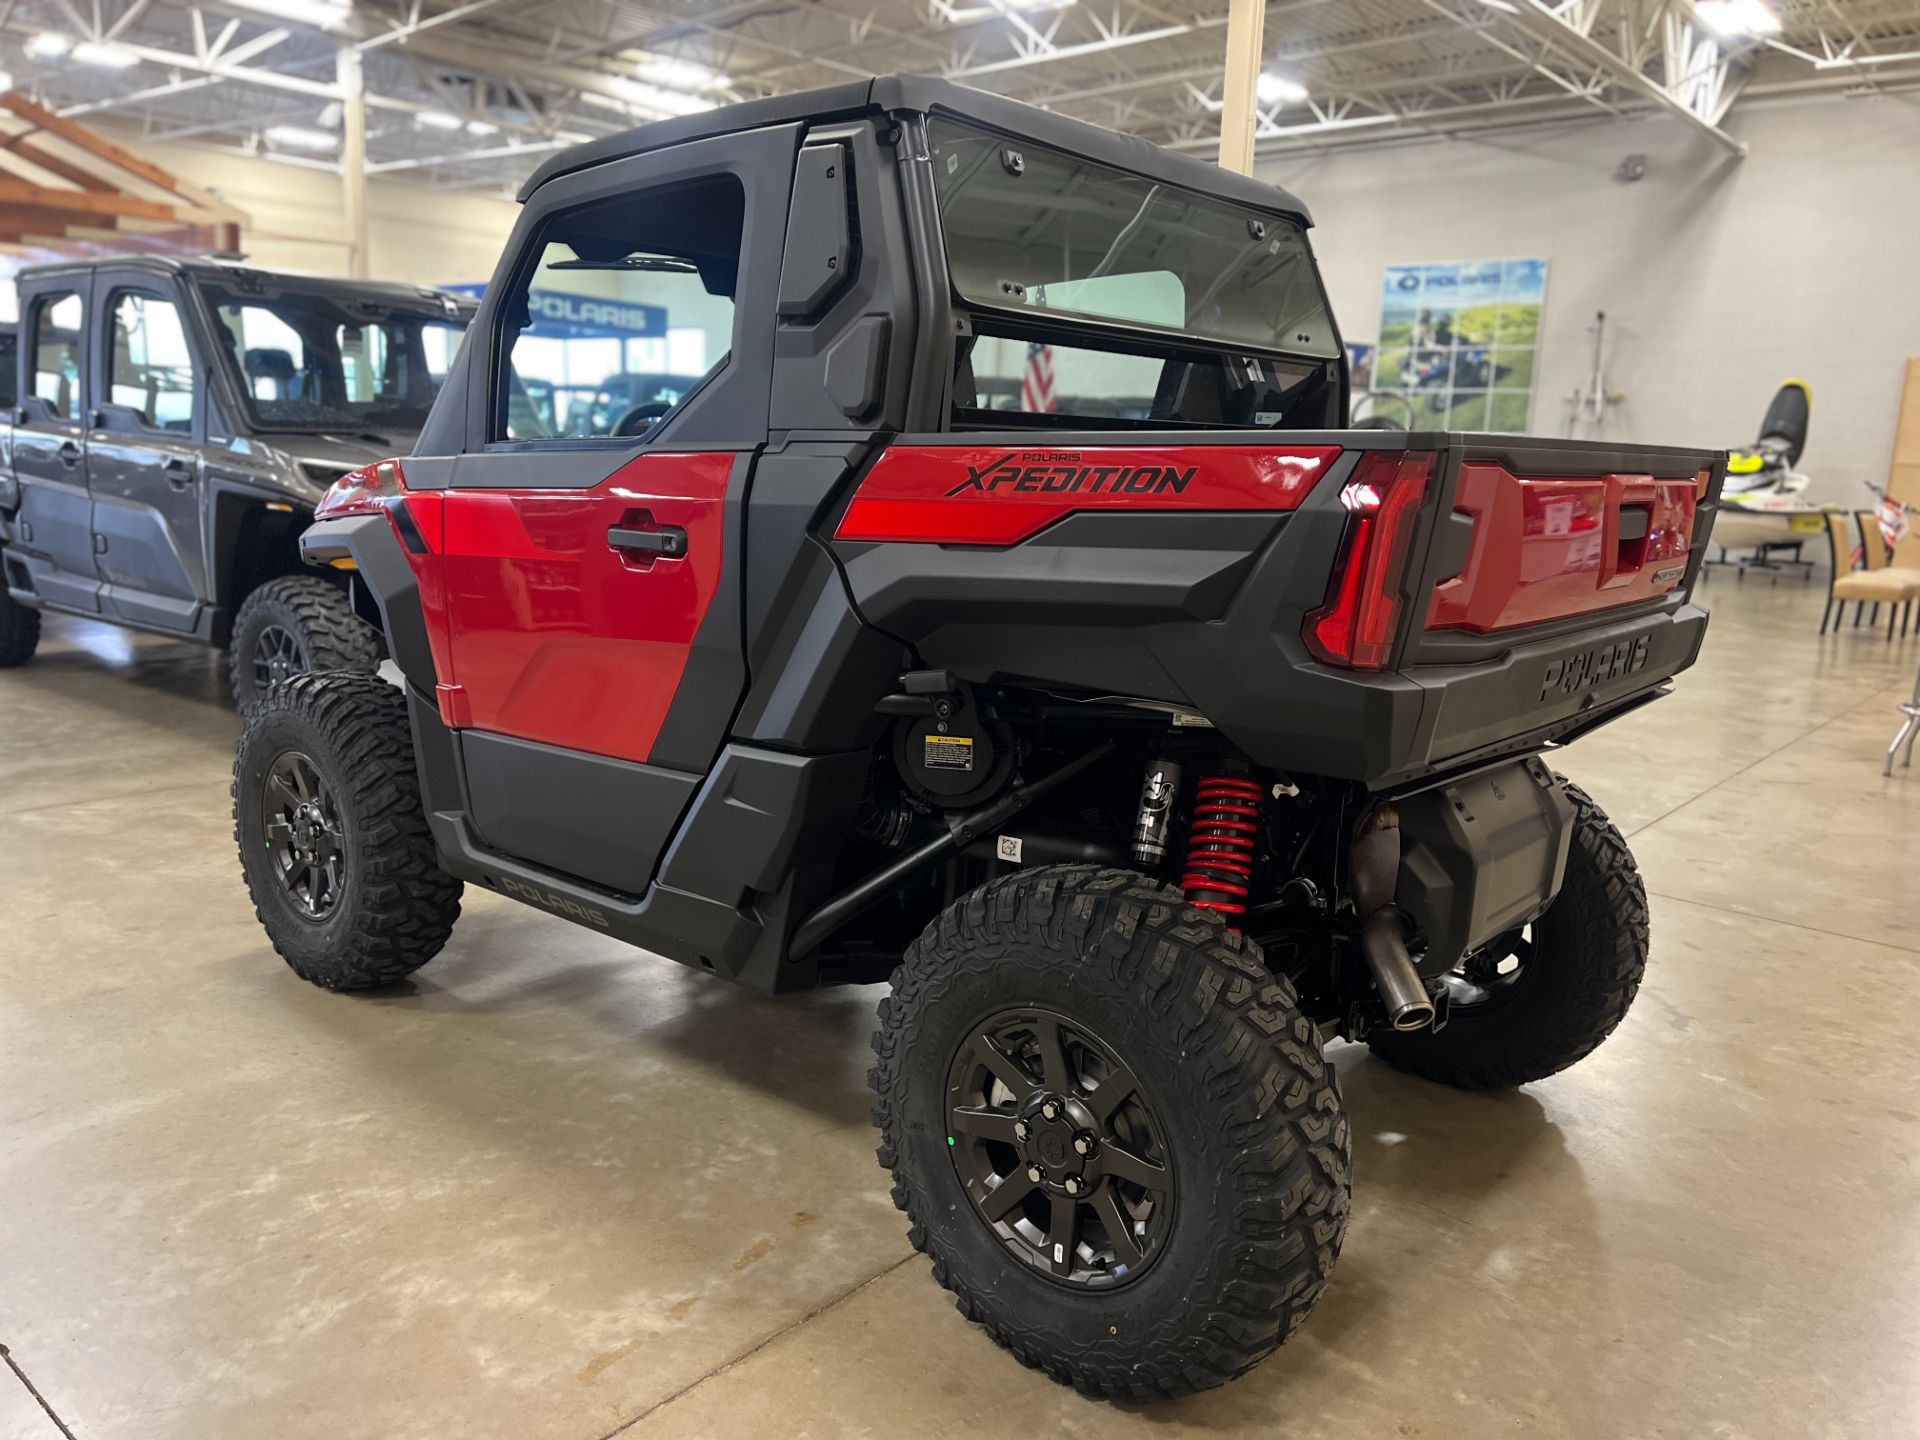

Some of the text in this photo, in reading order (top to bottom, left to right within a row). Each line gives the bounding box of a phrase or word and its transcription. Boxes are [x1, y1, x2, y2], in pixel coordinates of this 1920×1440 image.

[943, 453, 1199, 497] XPEDITION
[1022, 453, 1081, 462] POLARIS
[1540, 634, 1652, 702] POLARIS
[501, 877, 609, 928] POLARIS
